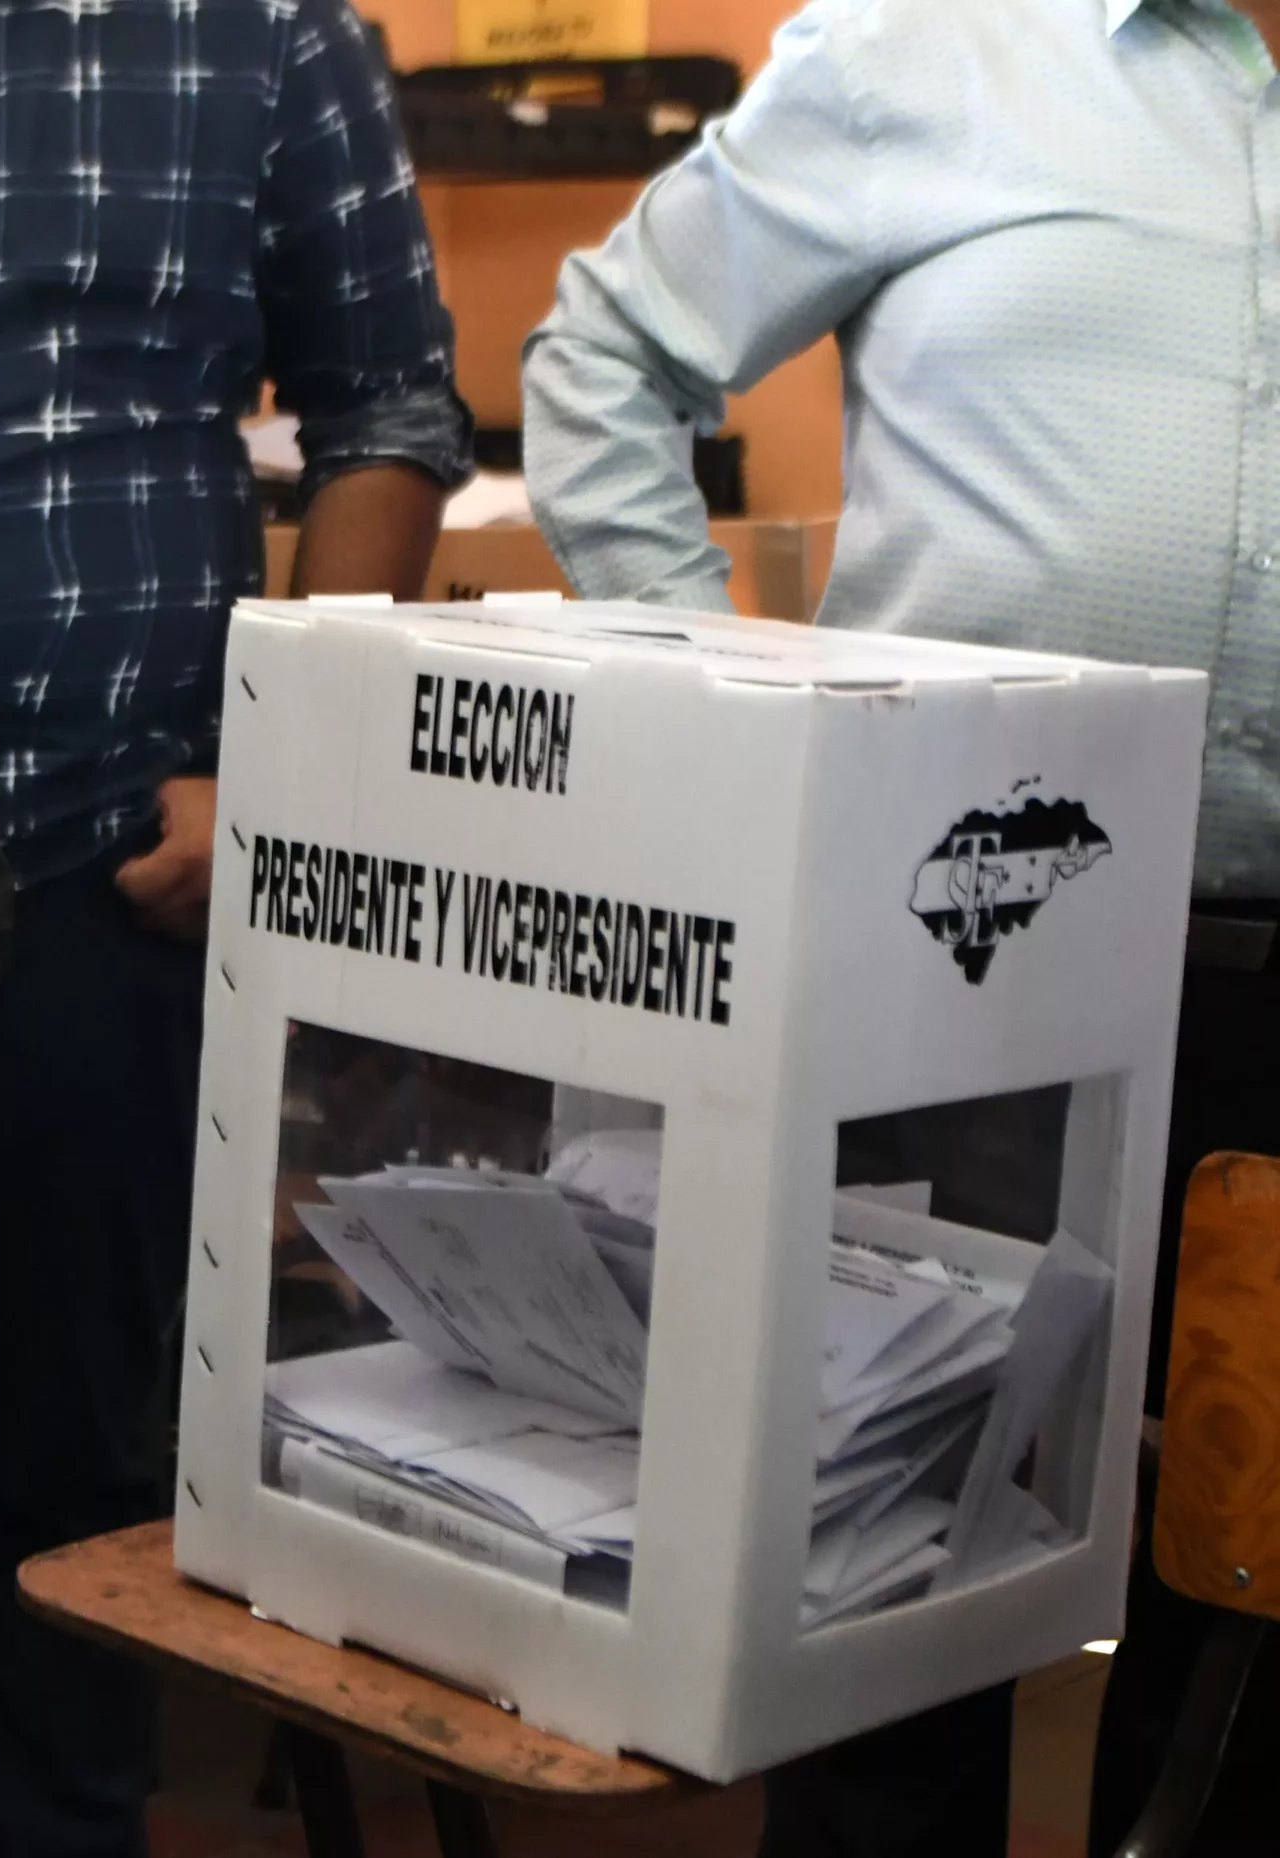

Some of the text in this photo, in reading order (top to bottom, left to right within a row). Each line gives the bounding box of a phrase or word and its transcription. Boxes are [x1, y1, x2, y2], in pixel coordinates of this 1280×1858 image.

[411, 674, 574, 794] ELECCION
[250, 835, 736, 1026] PRESIDENTE Y VICEPRESIDENTE
